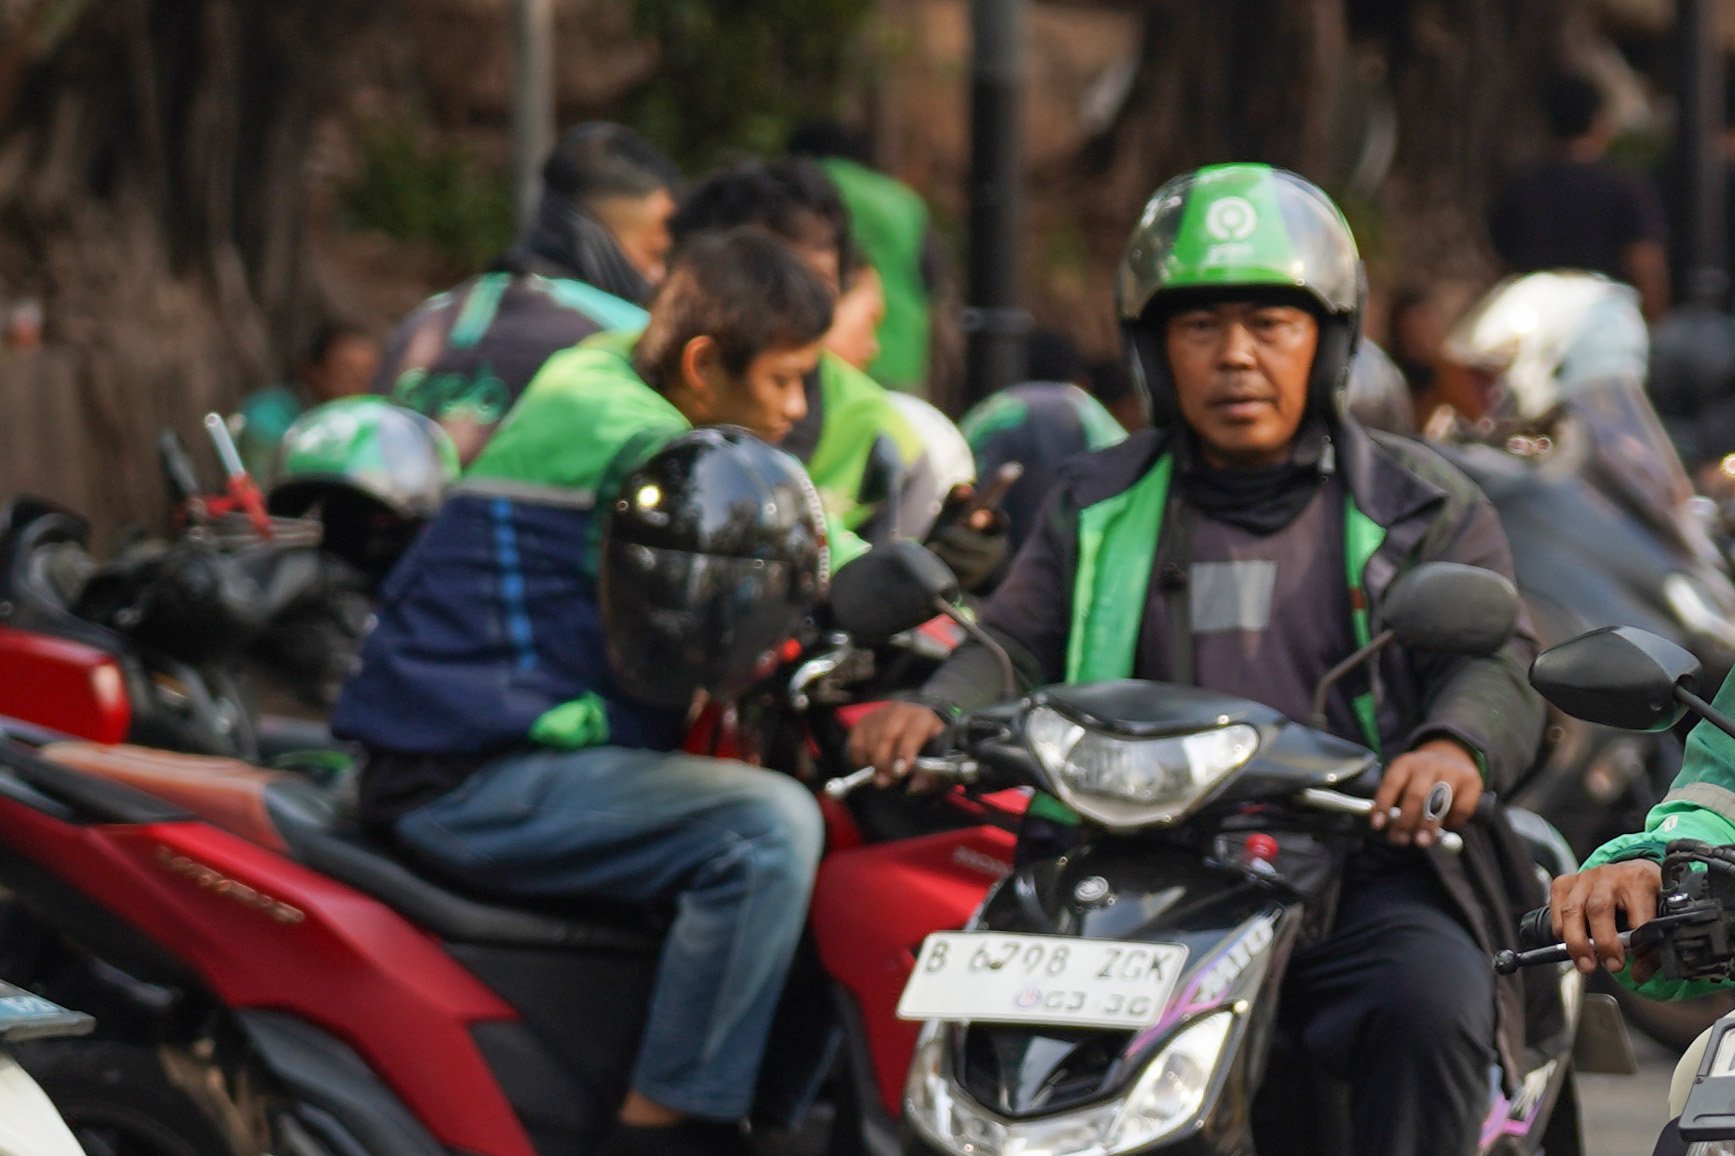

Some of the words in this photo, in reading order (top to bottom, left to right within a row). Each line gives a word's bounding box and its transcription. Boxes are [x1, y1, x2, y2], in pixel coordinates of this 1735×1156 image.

[925, 940, 949, 973] B
[970, 942, 1071, 976] 6798
[1096, 948, 1173, 981] ZGK
